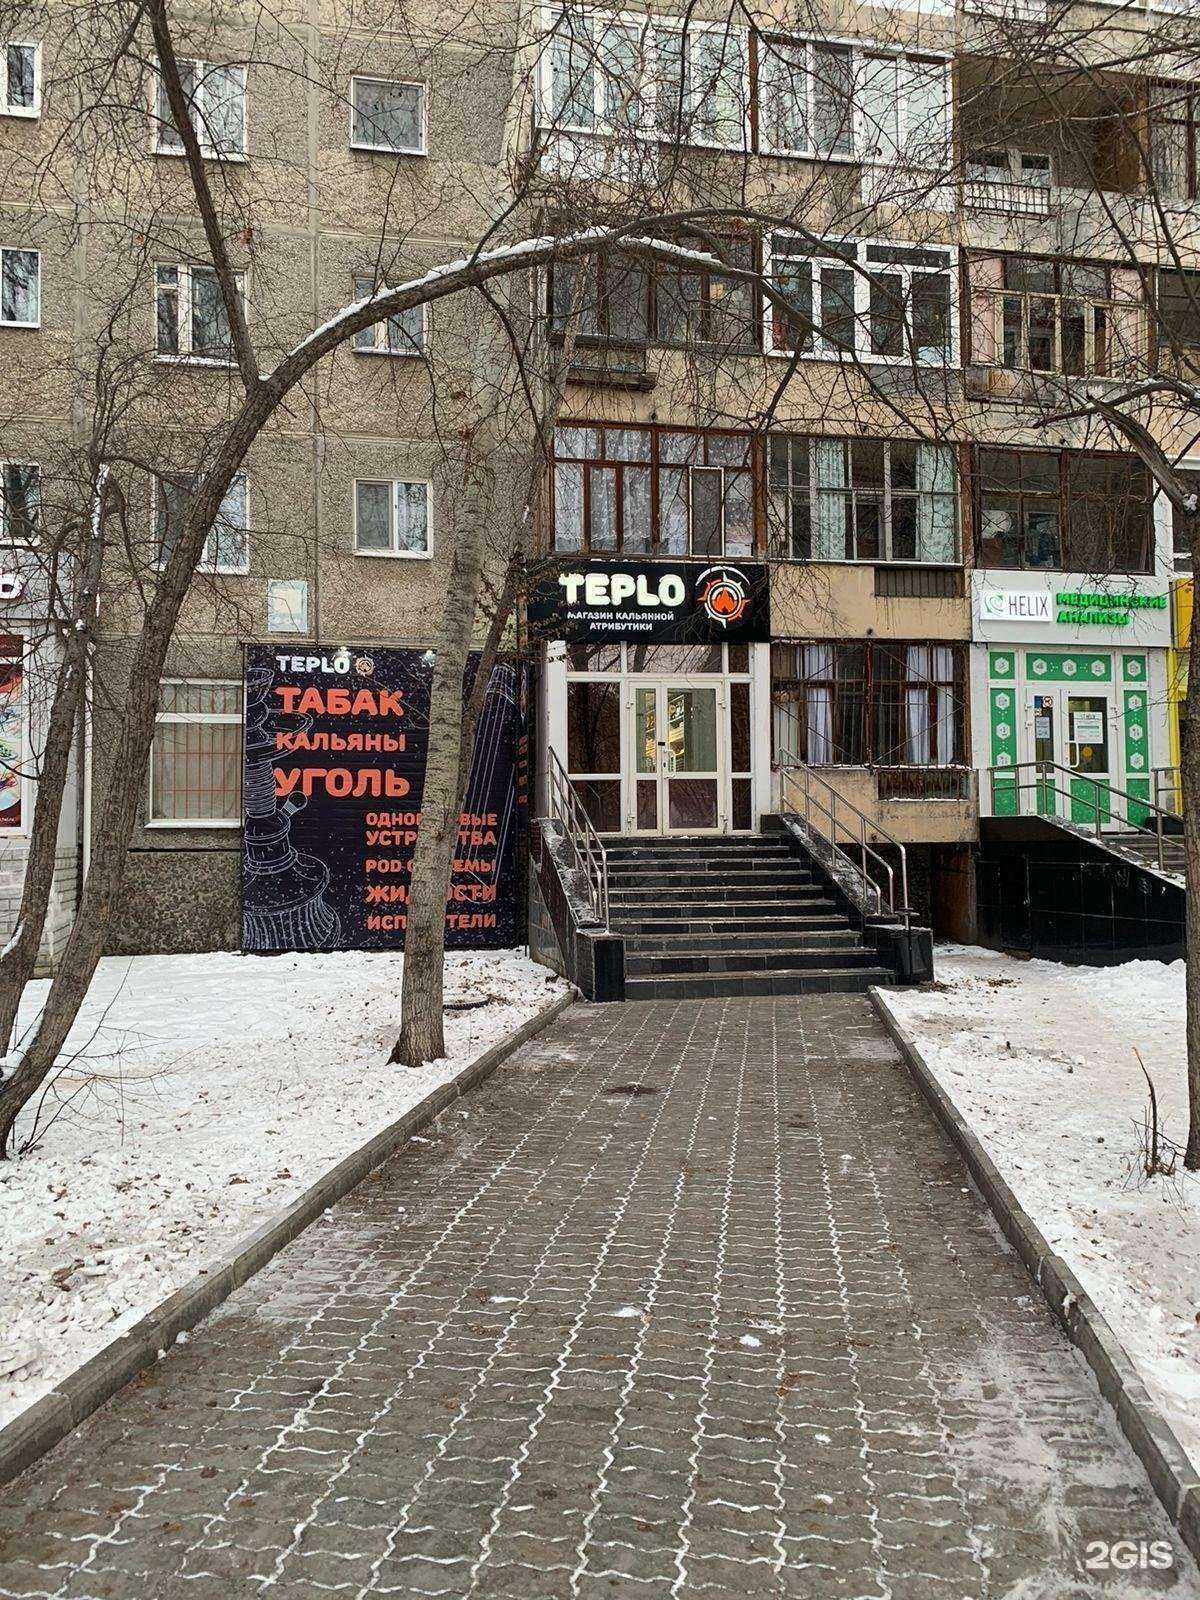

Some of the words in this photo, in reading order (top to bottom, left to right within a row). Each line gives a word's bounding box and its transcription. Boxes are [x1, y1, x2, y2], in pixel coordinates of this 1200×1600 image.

[558, 573, 686, 606] TEPLO
[1008, 595, 1049, 617] HELIX
[567, 611, 613, 621] МАГАЗИН
[615, 610, 675, 622] КАЛЬЯННОЙ
[589, 621, 653, 632] АТРИБУТИКИ
[276, 655, 350, 674] TEPLO
[275, 686, 405, 716] ТАБАК
[275, 732, 407, 752] КАЛЬЯНЫ
[273, 767, 411, 797] УГОЛЬ
[366, 830, 497, 845] УСТРТВА
[366, 913, 497, 929] ИСПТЕЛИ
